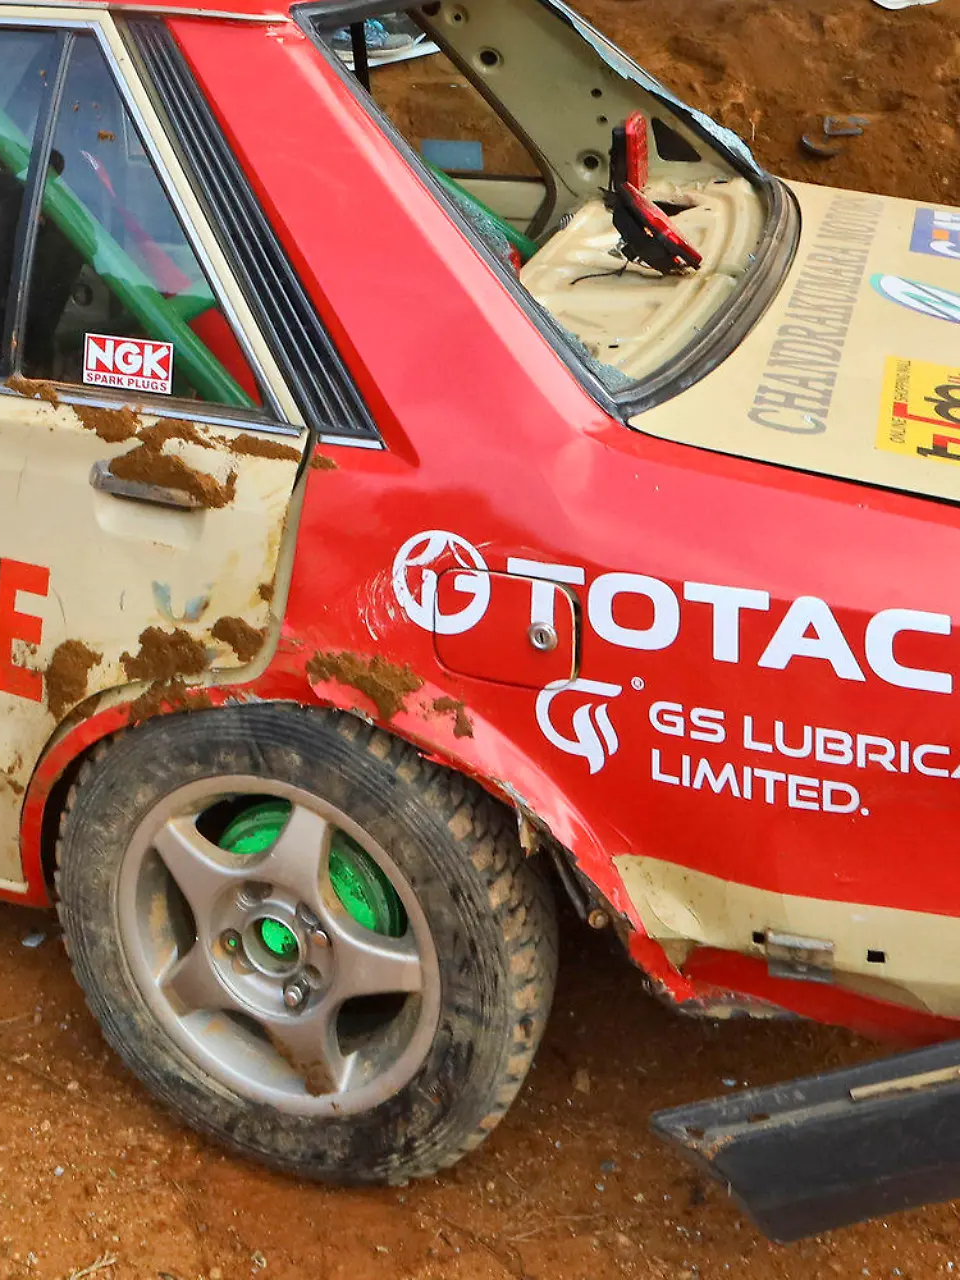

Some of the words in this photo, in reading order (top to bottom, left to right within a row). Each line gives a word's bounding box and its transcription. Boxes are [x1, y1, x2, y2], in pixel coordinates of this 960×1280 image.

[87, 338, 169, 380] NGK
[86, 372, 124, 387] SPARK
[127, 378, 167, 392] PLUGS
[507, 557, 952, 694] TOTAC
[649, 700, 726, 741] GS
[651, 748, 870, 816] LIMITED.
